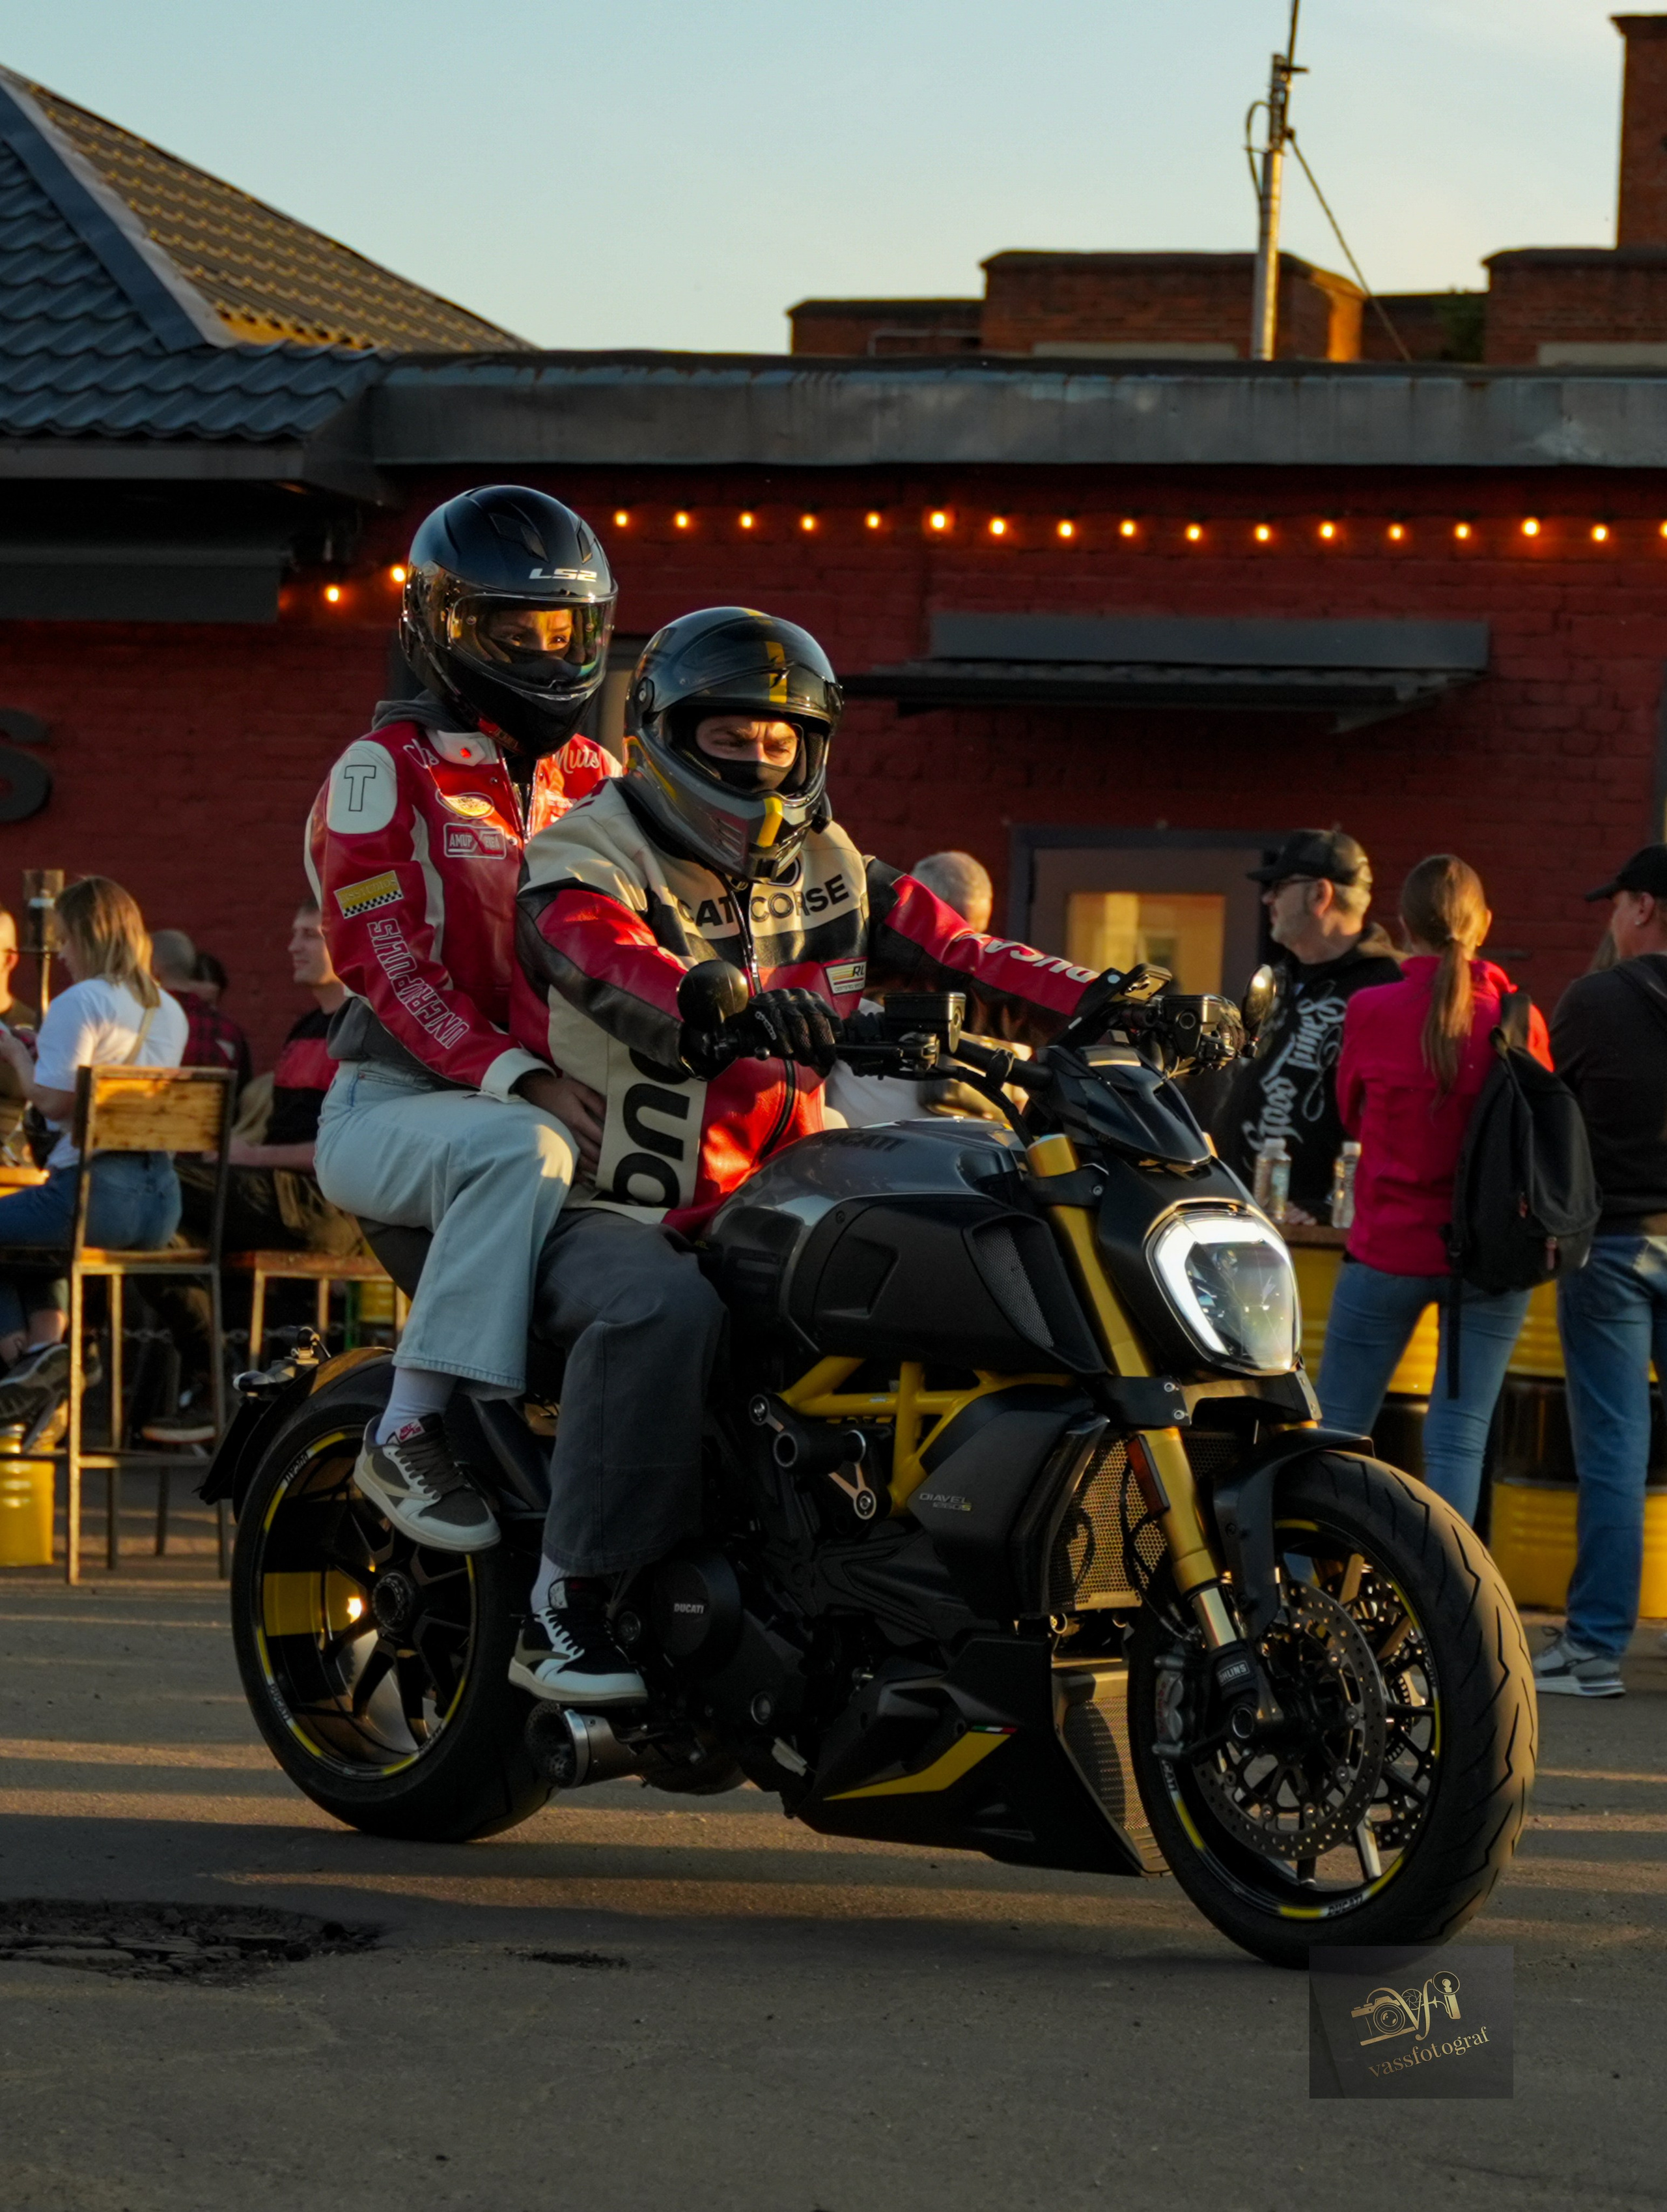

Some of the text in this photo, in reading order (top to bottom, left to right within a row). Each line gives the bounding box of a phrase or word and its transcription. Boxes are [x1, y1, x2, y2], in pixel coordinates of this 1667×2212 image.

[528, 567, 598, 582] LS2
[344, 764, 376, 812] T
[750, 873, 850, 923] CORSE
[918, 1492, 971, 1505] DIAVEL
[673, 1602, 705, 1615] DUCATI
